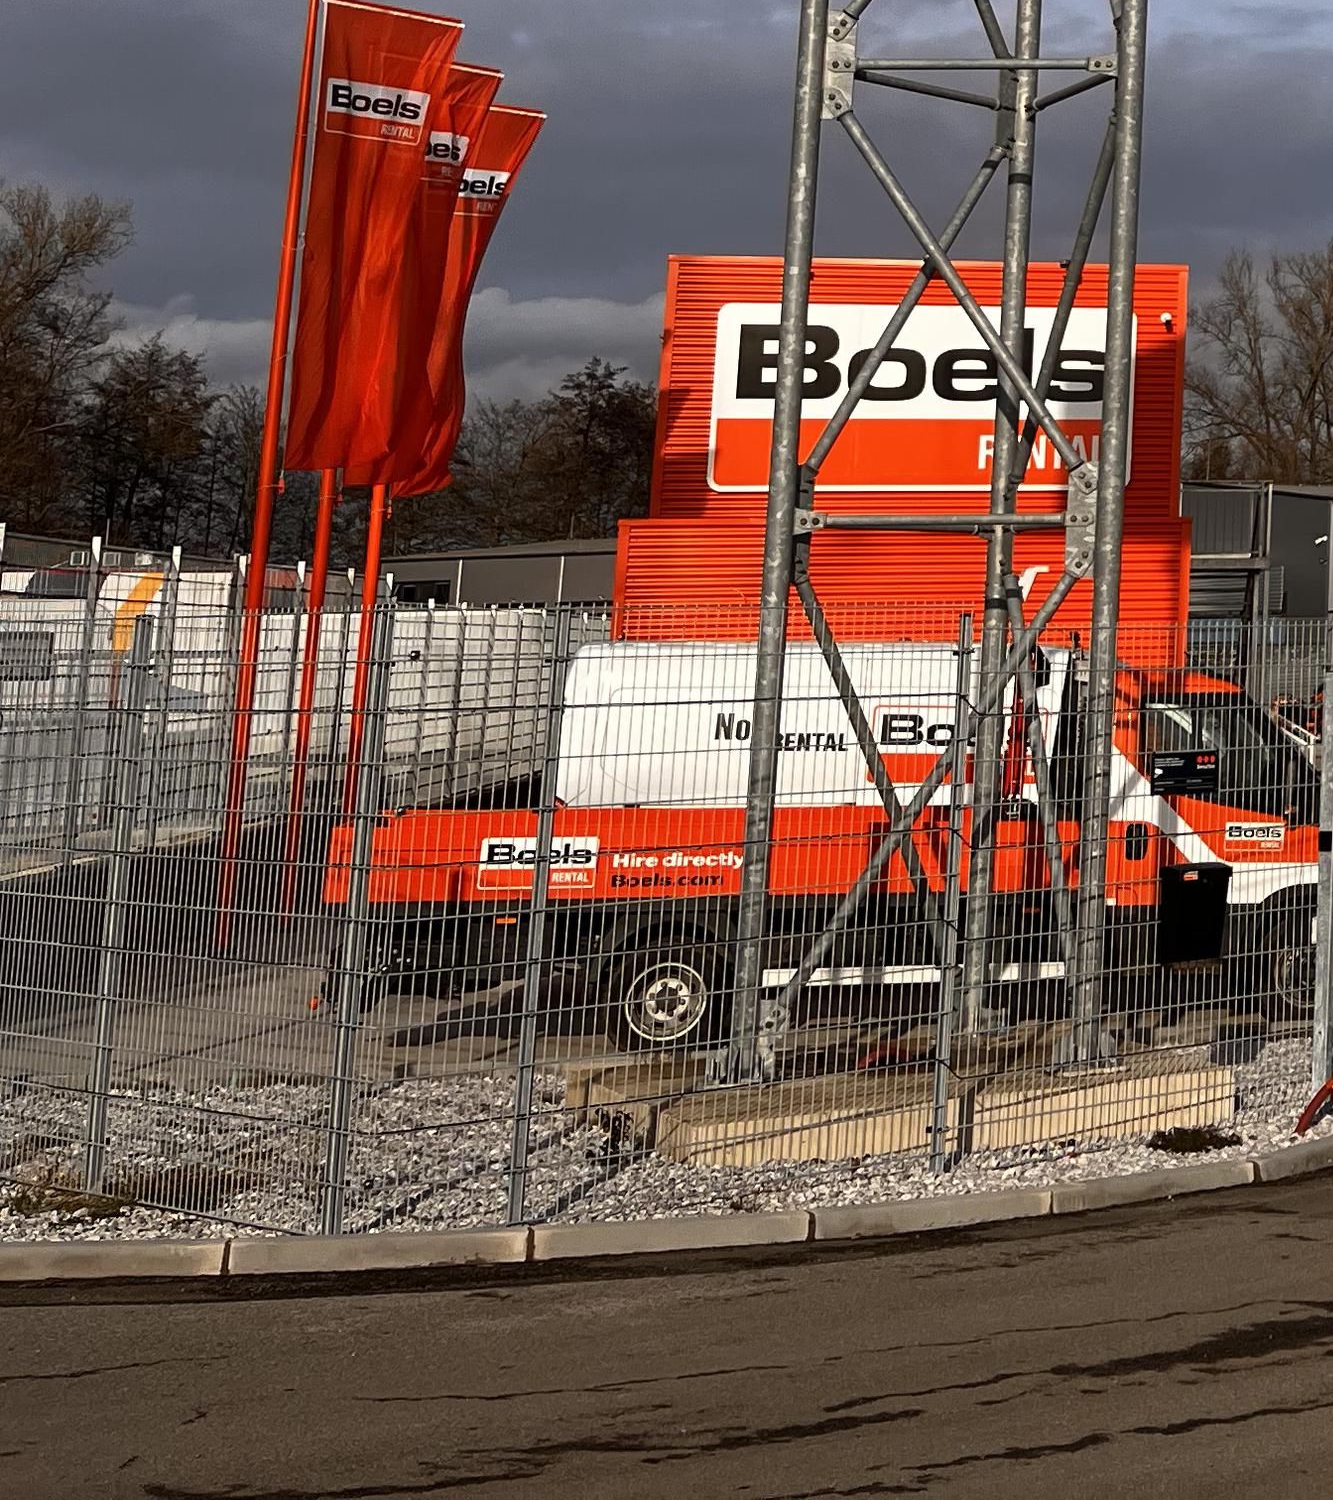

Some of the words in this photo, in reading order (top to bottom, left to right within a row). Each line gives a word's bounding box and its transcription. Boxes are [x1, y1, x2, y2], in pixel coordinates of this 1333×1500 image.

[331, 83, 422, 120] Boels
[612, 852, 656, 868] Hire
[662, 850, 744, 870] directly
[552, 871, 589, 883] RENTAL
[611, 872, 723, 888] Boels.com
